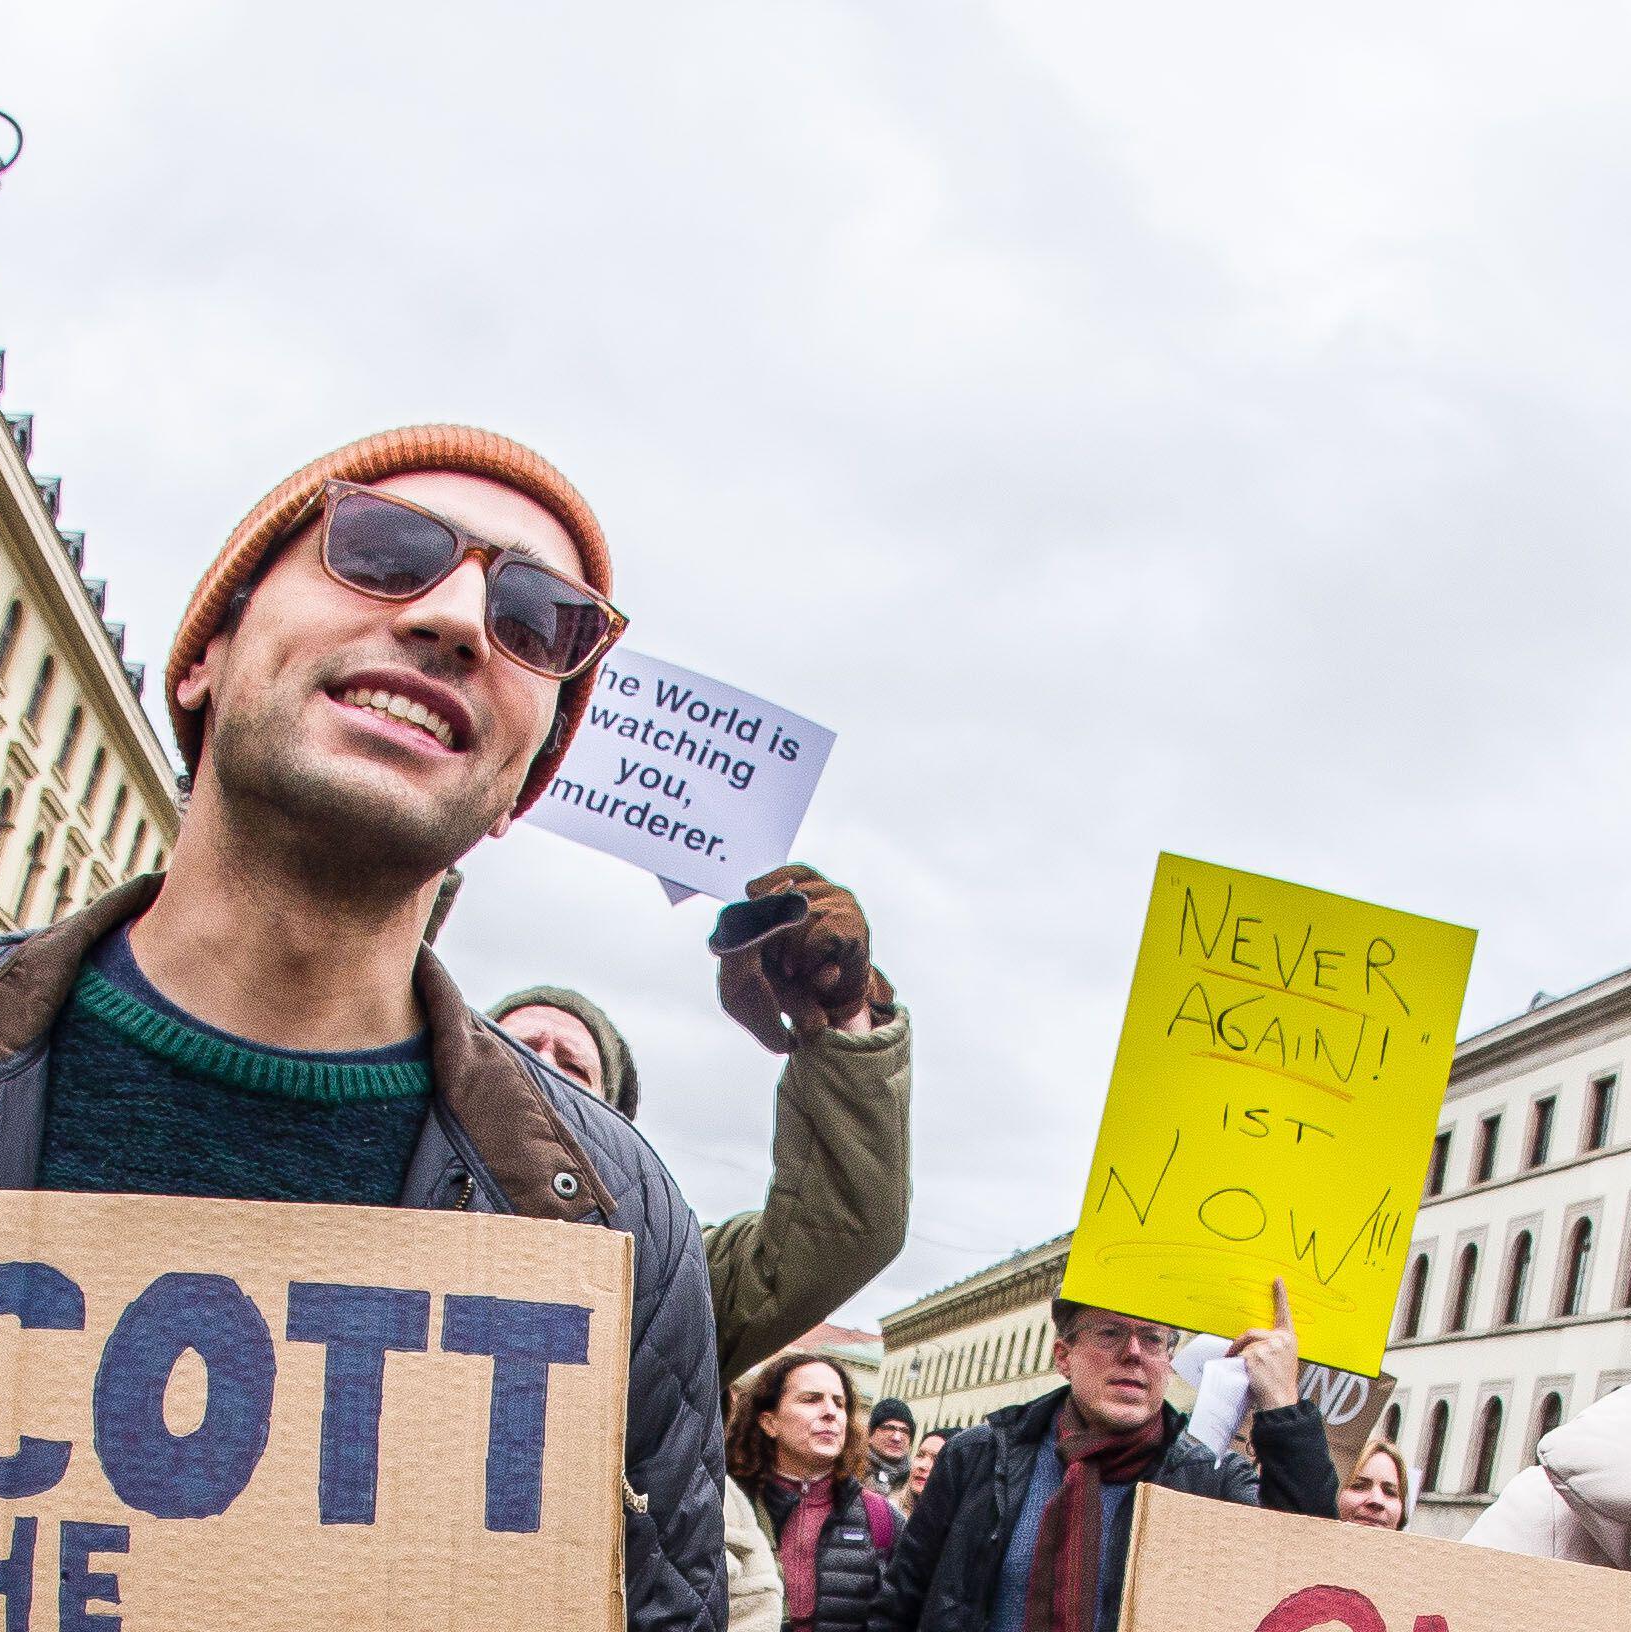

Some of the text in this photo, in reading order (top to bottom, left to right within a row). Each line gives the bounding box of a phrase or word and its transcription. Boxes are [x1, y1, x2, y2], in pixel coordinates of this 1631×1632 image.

[589, 703, 757, 791] watching
[597, 662, 801, 763] he World is
[549, 775, 728, 863] murderer.
[613, 756, 692, 810] you,
[1221, 1101, 1336, 1144] IST
